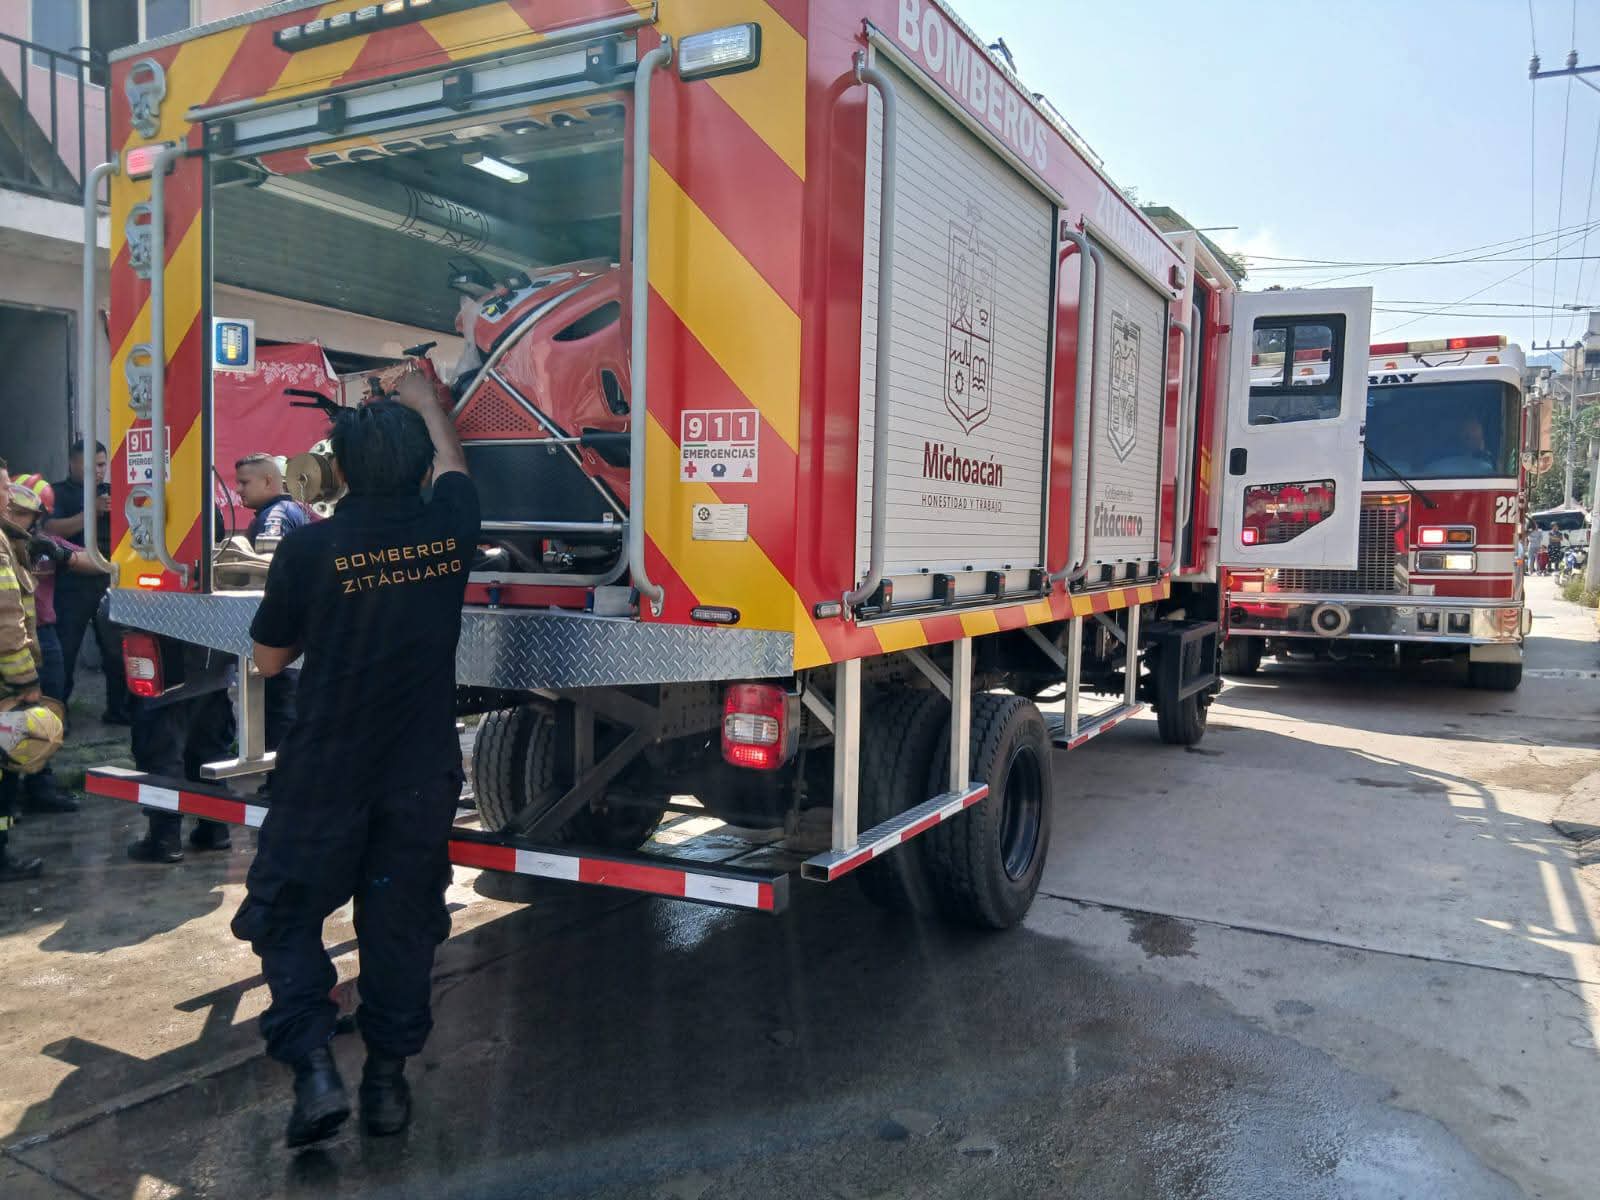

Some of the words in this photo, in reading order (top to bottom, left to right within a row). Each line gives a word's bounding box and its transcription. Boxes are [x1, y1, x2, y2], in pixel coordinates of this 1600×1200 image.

[898, 0, 1048, 171] BOMBEROS
[688, 416, 748, 439] 911
[683, 448, 756, 459] EMERGENCIAS
[923, 441, 1003, 487] Michoacán
[921, 494, 968, 509] HONESTIDAD
[1093, 501, 1143, 537] Zitácuaro
[335, 538, 456, 571] BOMBEROS
[342, 559, 462, 593] ZITÁCUARO
